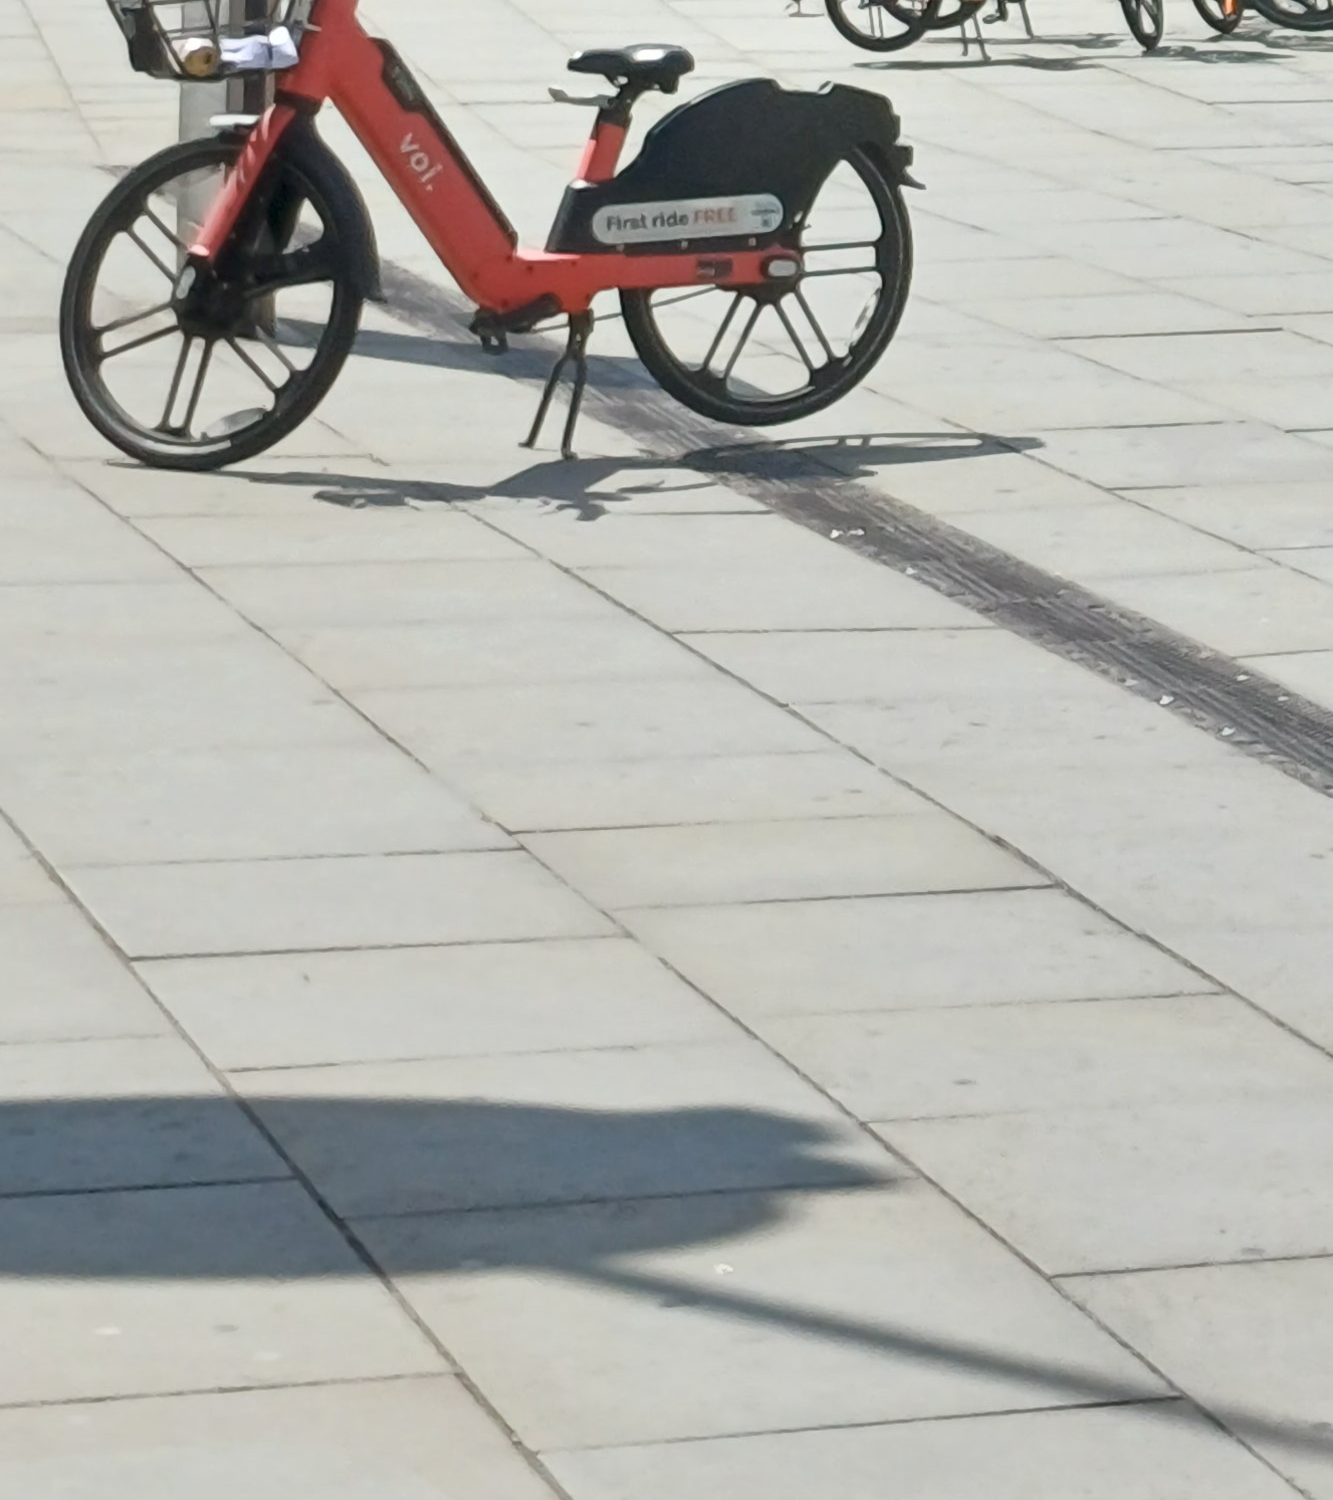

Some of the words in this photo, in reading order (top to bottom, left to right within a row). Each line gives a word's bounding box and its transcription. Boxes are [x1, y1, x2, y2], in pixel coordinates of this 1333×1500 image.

[606, 213, 648, 231] First
[651, 210, 689, 228] ride
[693, 207, 737, 225] FREE
